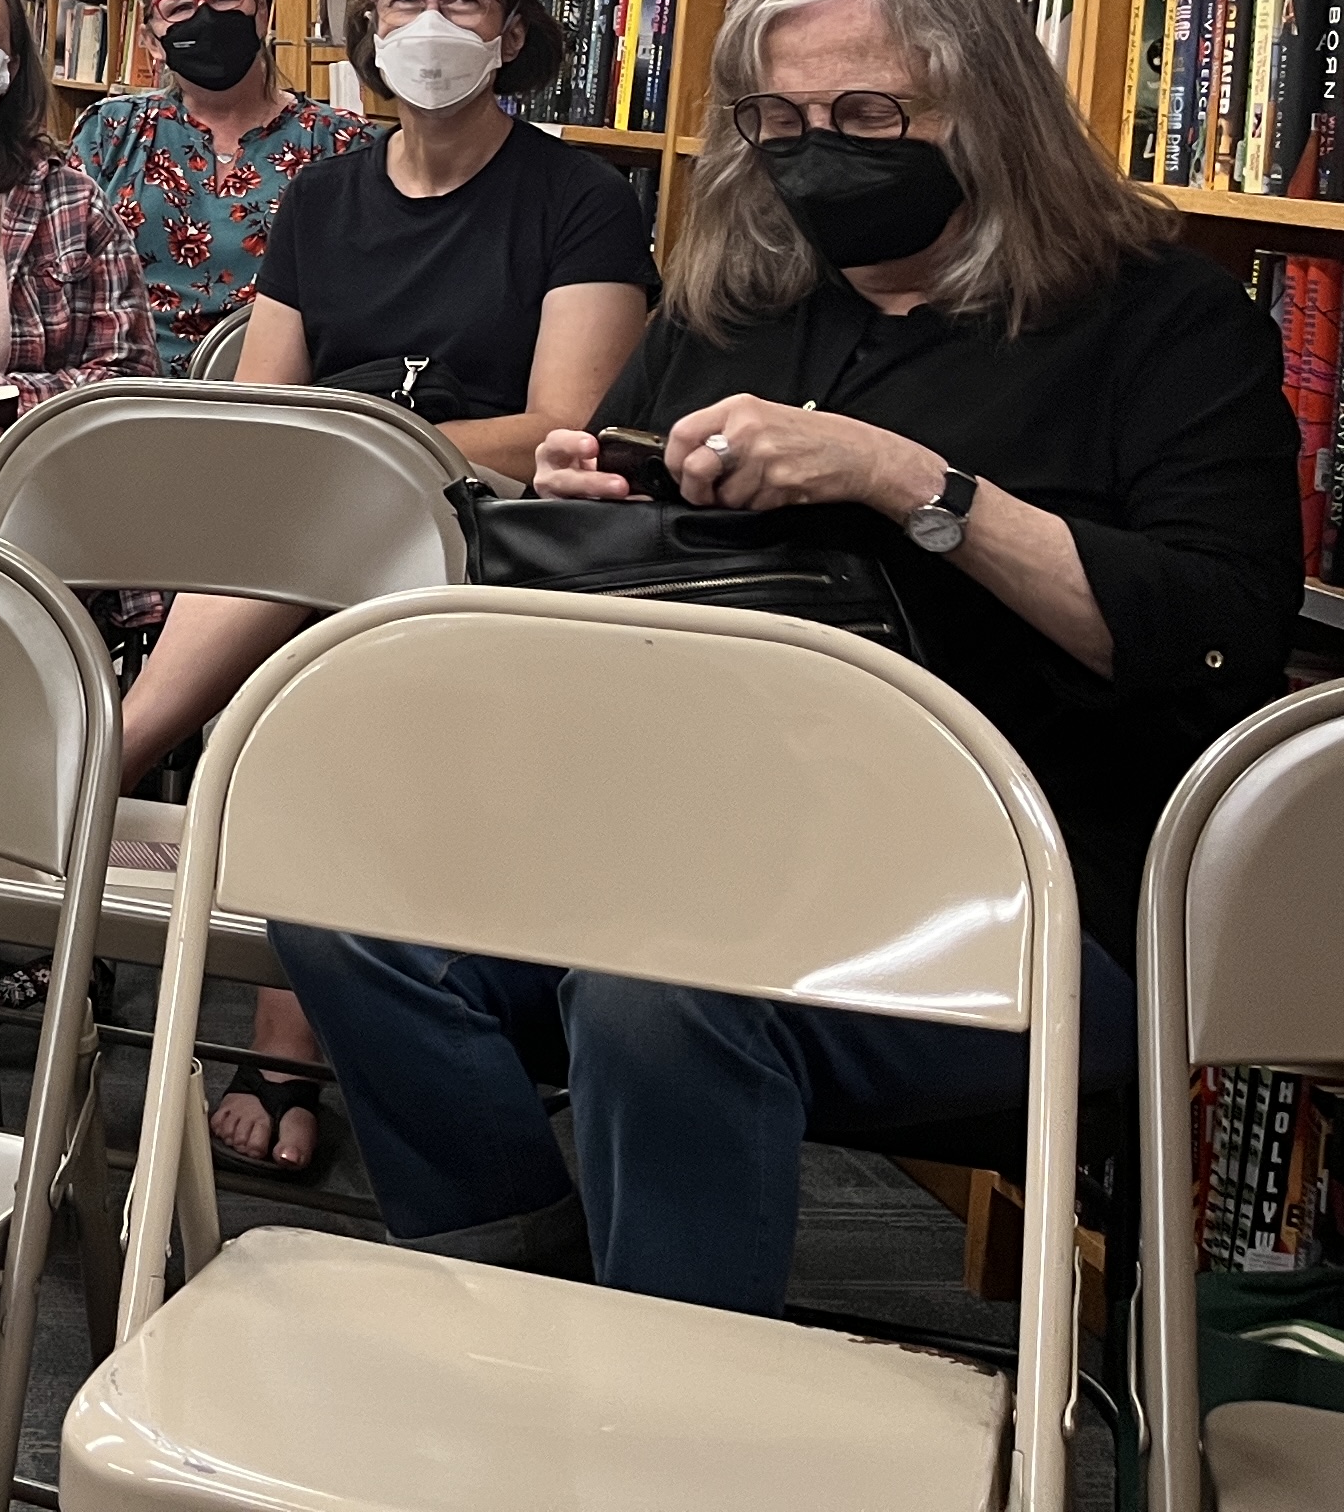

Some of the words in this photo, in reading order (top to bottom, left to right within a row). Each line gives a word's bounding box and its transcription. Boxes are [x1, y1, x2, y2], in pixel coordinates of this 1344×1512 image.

[1197, 19, 1214, 121] VIOLENCE
[1167, 85, 1186, 132] FIONA
[1164, 133, 1182, 172] DAVIS
[1330, 458, 1344, 528] STORY
